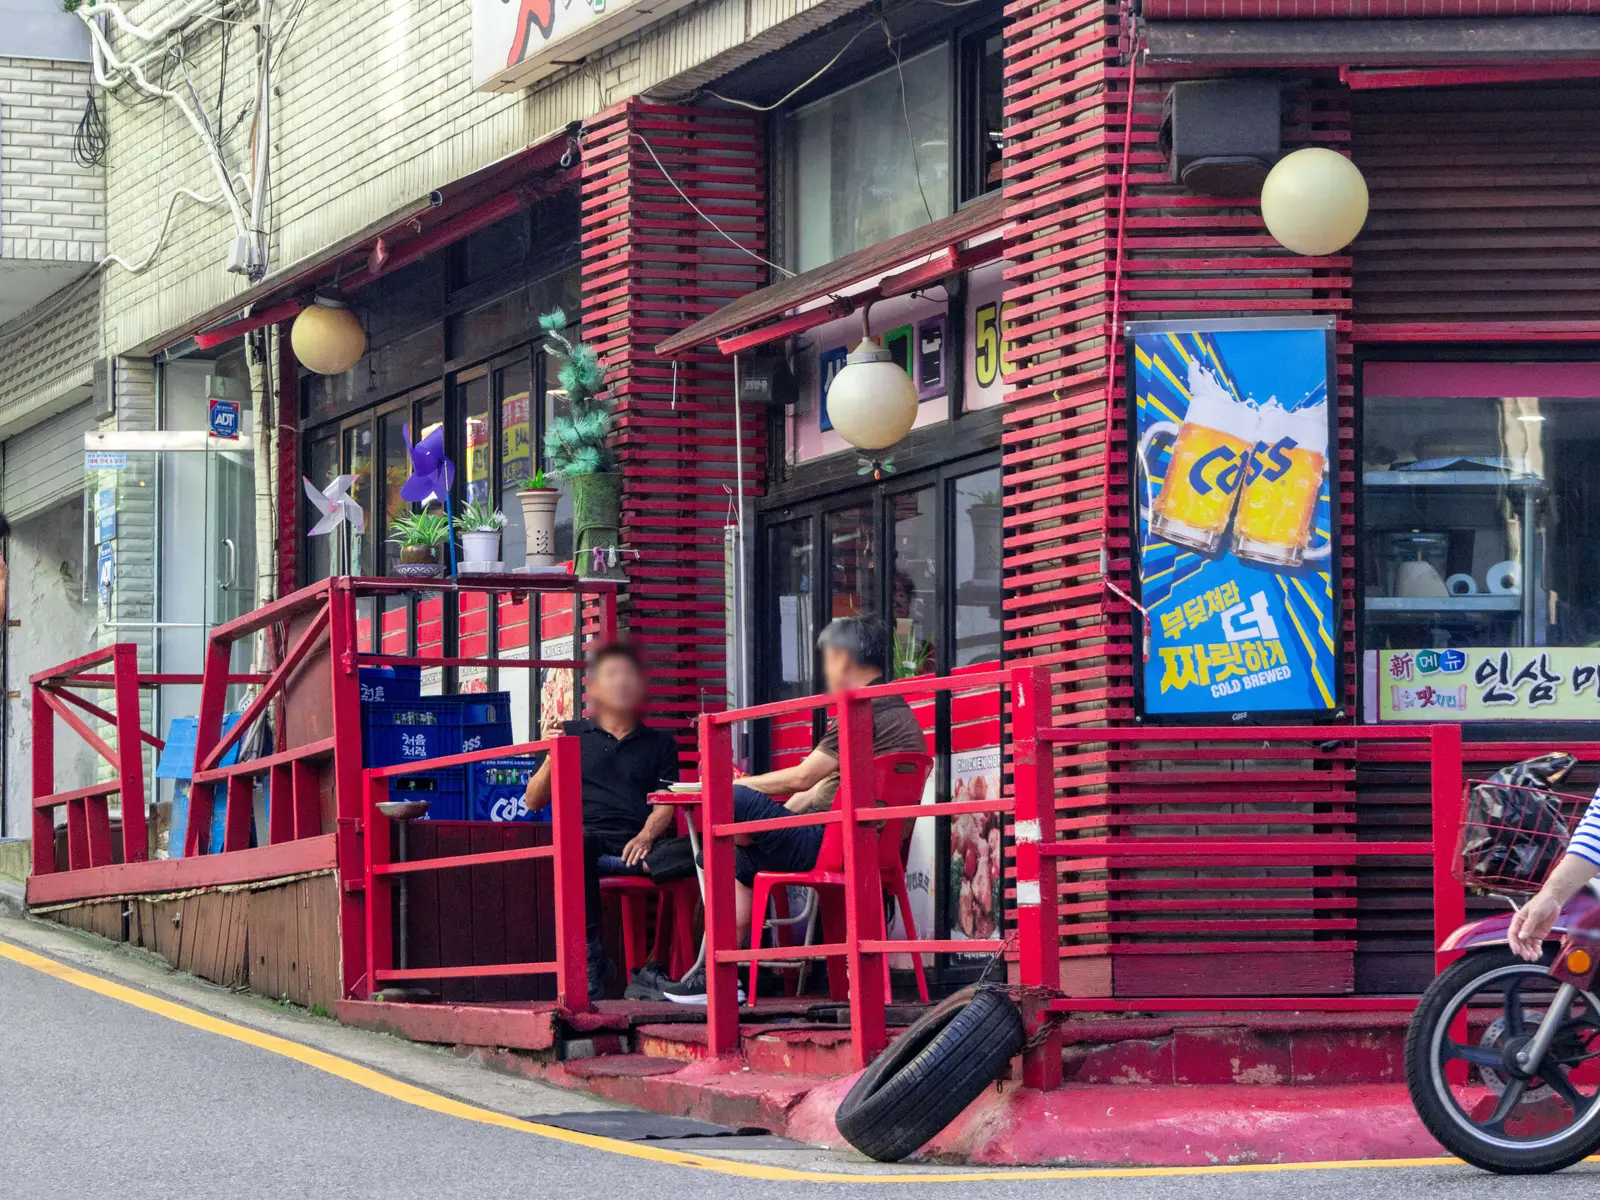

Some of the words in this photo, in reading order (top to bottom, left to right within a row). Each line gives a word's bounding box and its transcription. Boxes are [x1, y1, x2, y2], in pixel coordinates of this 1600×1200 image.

[214, 412, 235, 427] ADT
[1189, 436, 1298, 495] Cass
[1220, 590, 1280, 642] 더
[1158, 639, 1289, 695] 짜릿하게
[1474, 651, 1561, 704] 인삼
[1210, 679, 1241, 698] COLD
[1242, 666, 1292, 690] BREWED
[1231, 711, 1248, 721] Cass
[402, 733, 426, 746] 처음
[402, 745, 427, 757] 처럼
[956, 756, 986, 774] CHICKEN
[490, 793, 529, 822] Cas
